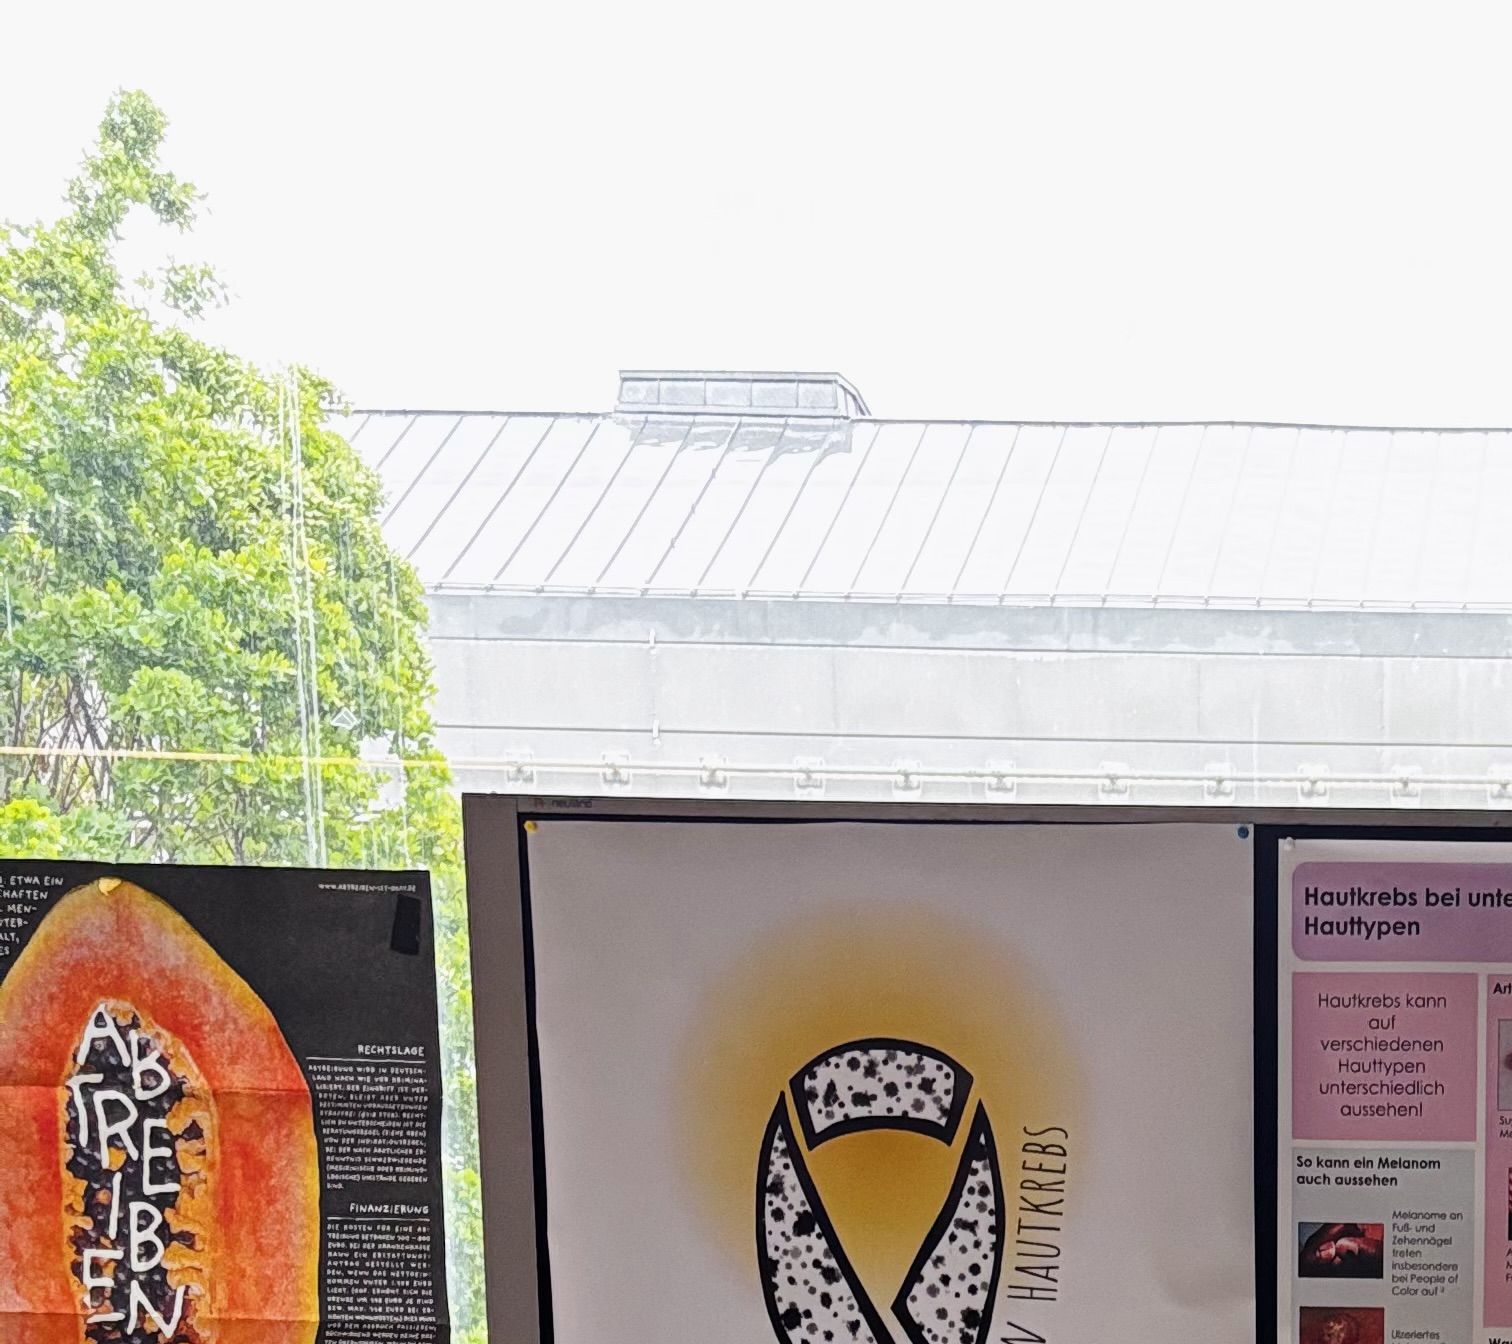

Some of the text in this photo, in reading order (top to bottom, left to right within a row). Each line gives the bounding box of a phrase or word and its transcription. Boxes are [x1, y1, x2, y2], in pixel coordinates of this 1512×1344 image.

[10, 876, 63, 886] ETWA EIN
[1305, 887, 1417, 906] Hautkrebs
[1426, 888, 1460, 907] bei
[8, 904, 37, 913] MEN-
[1305, 916, 1419, 940] Hauttypen
[1319, 993, 1446, 1008] Hautkrebs kann
[1369, 1015, 1395, 1030] auf
[1321, 1036, 1443, 1052] verschiedenen
[358, 1045, 424, 1056] RECHTSLAGE
[1339, 1058, 1425, 1076] Hauttypen
[1320, 1080, 1444, 1095] unterschiedlich
[1340, 1102, 1422, 1117] aussehen!
[1297, 1156, 1440, 1169] So kann ein Melanom
[1297, 1173, 1397, 1186] auch aussehen
[350, 1203, 428, 1214] FINANZIERUNG
[1007, 1126, 1068, 1301] HAUTKREBS
[1392, 1211, 1447, 1220] Melanome
[1415, 1224, 1435, 1233] und
[1392, 1235, 1452, 1247] Zehennägel
[1393, 1249, 1422, 1258] treten
[1392, 1261, 1458, 1271] insbesondere
[1392, 1274, 1458, 1285] bei People of
[1392, 1286, 1418, 1296] Color
[1421, 1287, 1438, 1296] auf
[1392, 1330, 1440, 1340] Ulzeriertes
